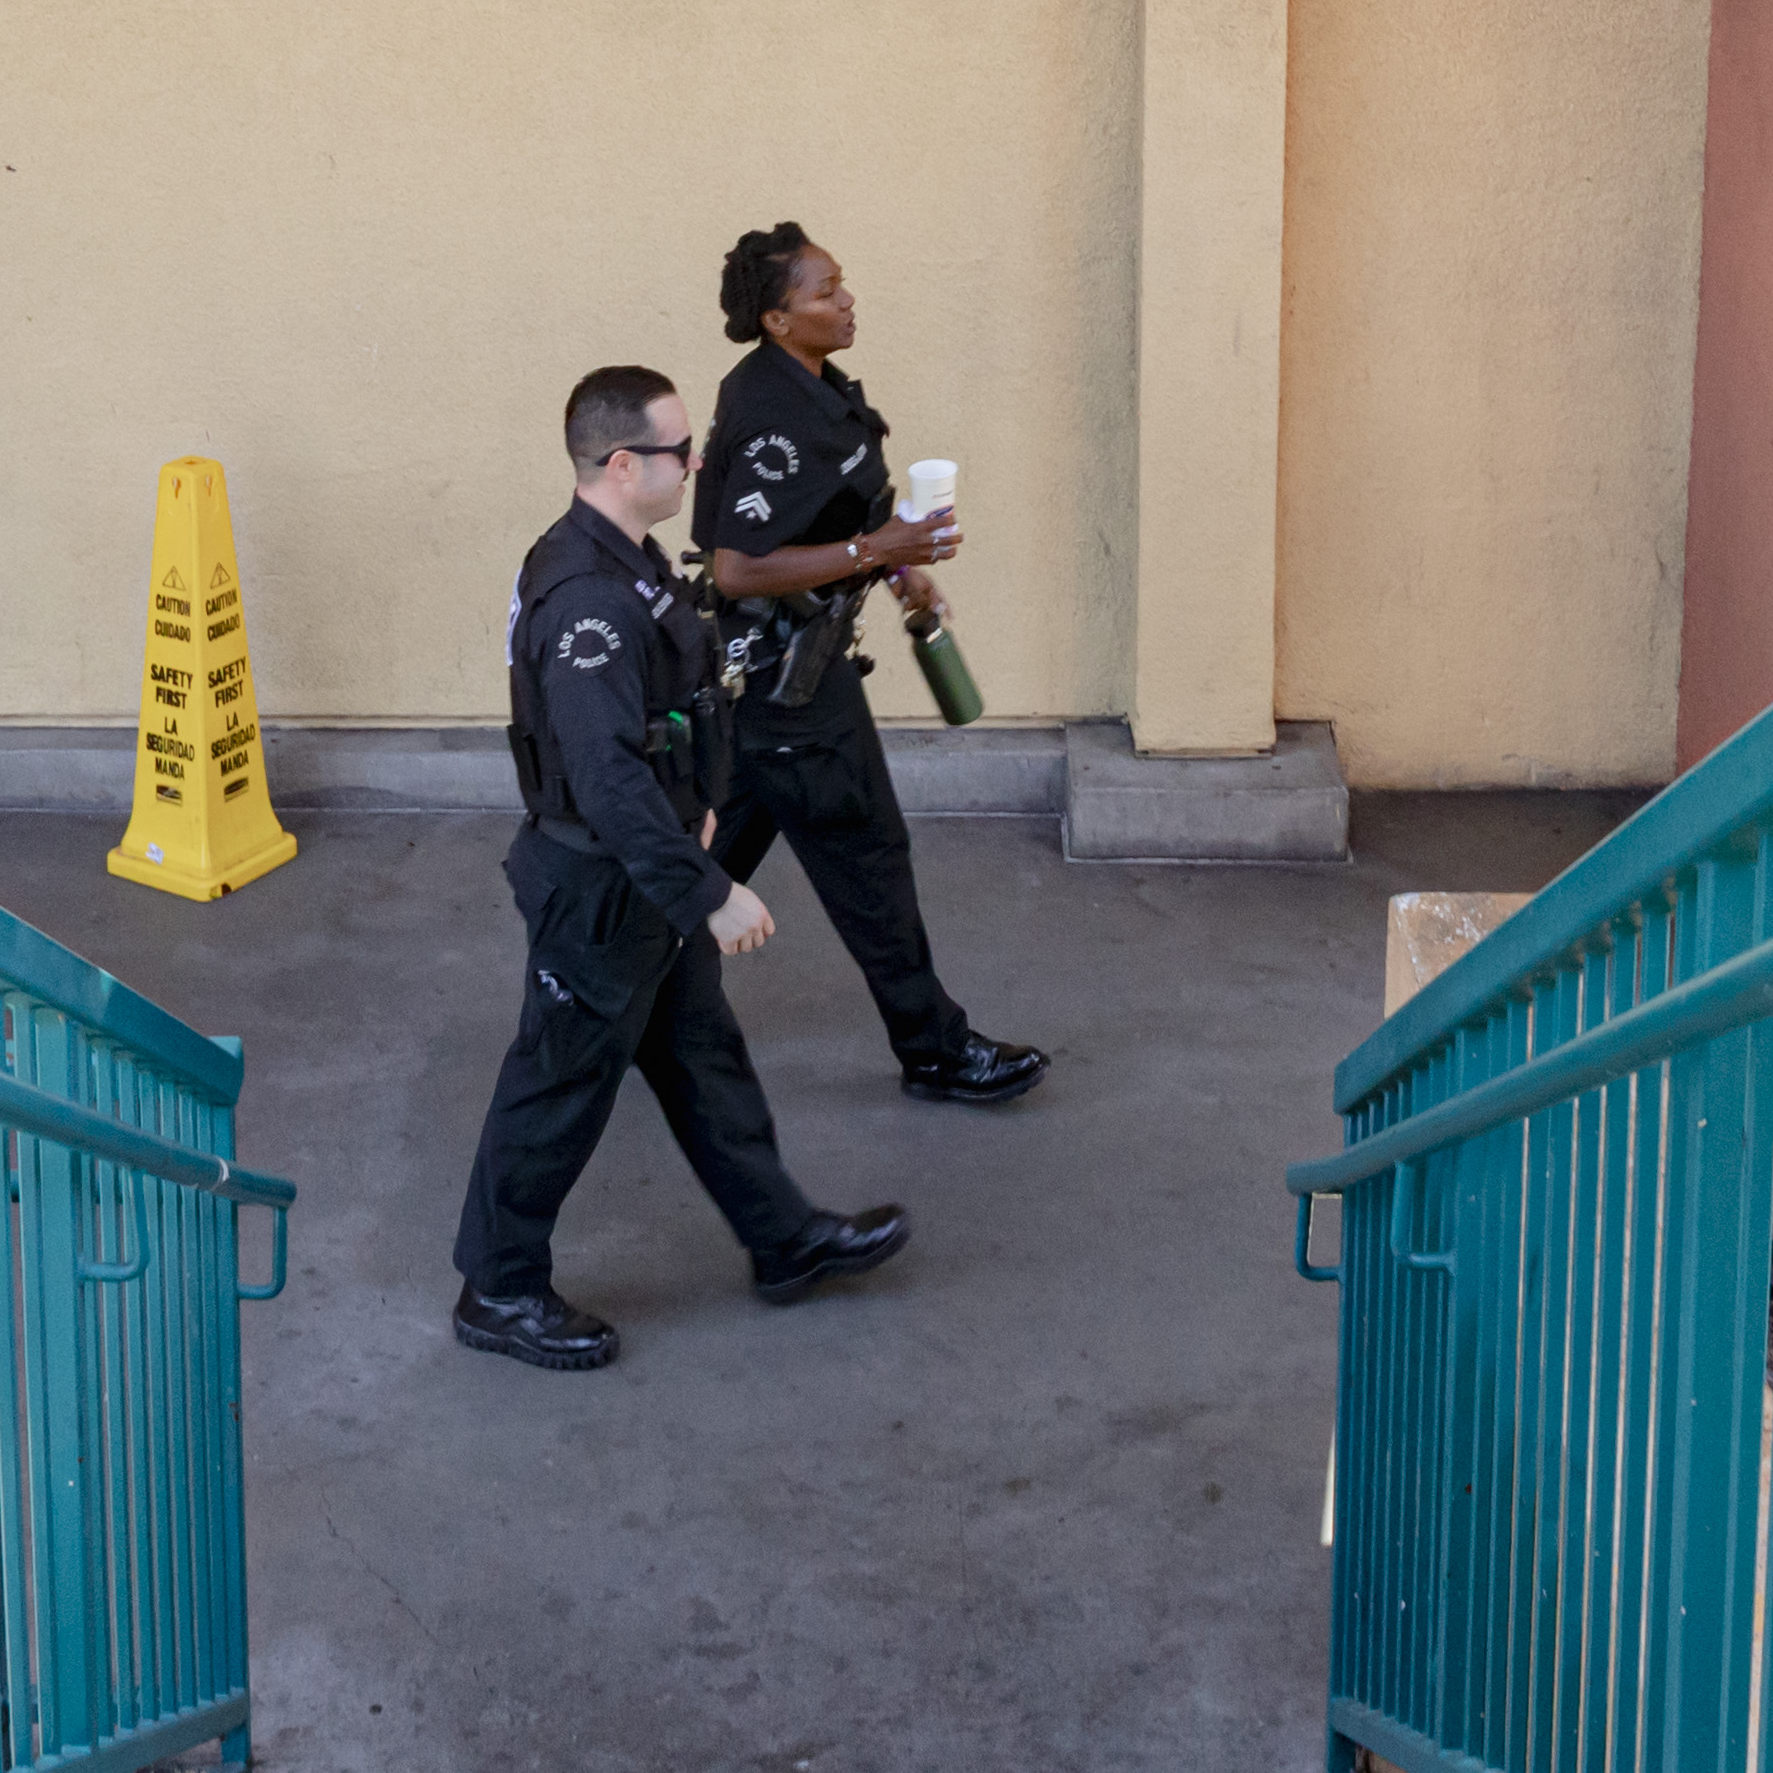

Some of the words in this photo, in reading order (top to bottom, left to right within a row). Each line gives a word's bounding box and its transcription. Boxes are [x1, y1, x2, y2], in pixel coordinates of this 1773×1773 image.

[744, 437, 766, 457] LOS
[768, 434, 800, 474] ANGELES
[752, 461, 785, 481] POLICE
[156, 593, 191, 617] CAUTION
[205, 588, 237, 616] CAUTION
[155, 619, 191, 643] CUIDADO
[207, 613, 240, 642] CUIDADO
[557, 632, 575, 658] LOS
[574, 617, 621, 650] ANGELES
[208, 656, 246, 688] SAFETY
[572, 652, 610, 669] POLICE
[151, 663, 193, 690] SAFETY
[155, 686, 187, 709] FIRST
[214, 679, 243, 708] FIRST
[164, 716, 178, 736] LA
[226, 711, 239, 732] LA
[146, 731, 195, 762] SEGURIDAD
[211, 723, 255, 760] SEGURIDAD
[155, 756, 185, 780] MANDA
[220, 749, 249, 777] MANDA
